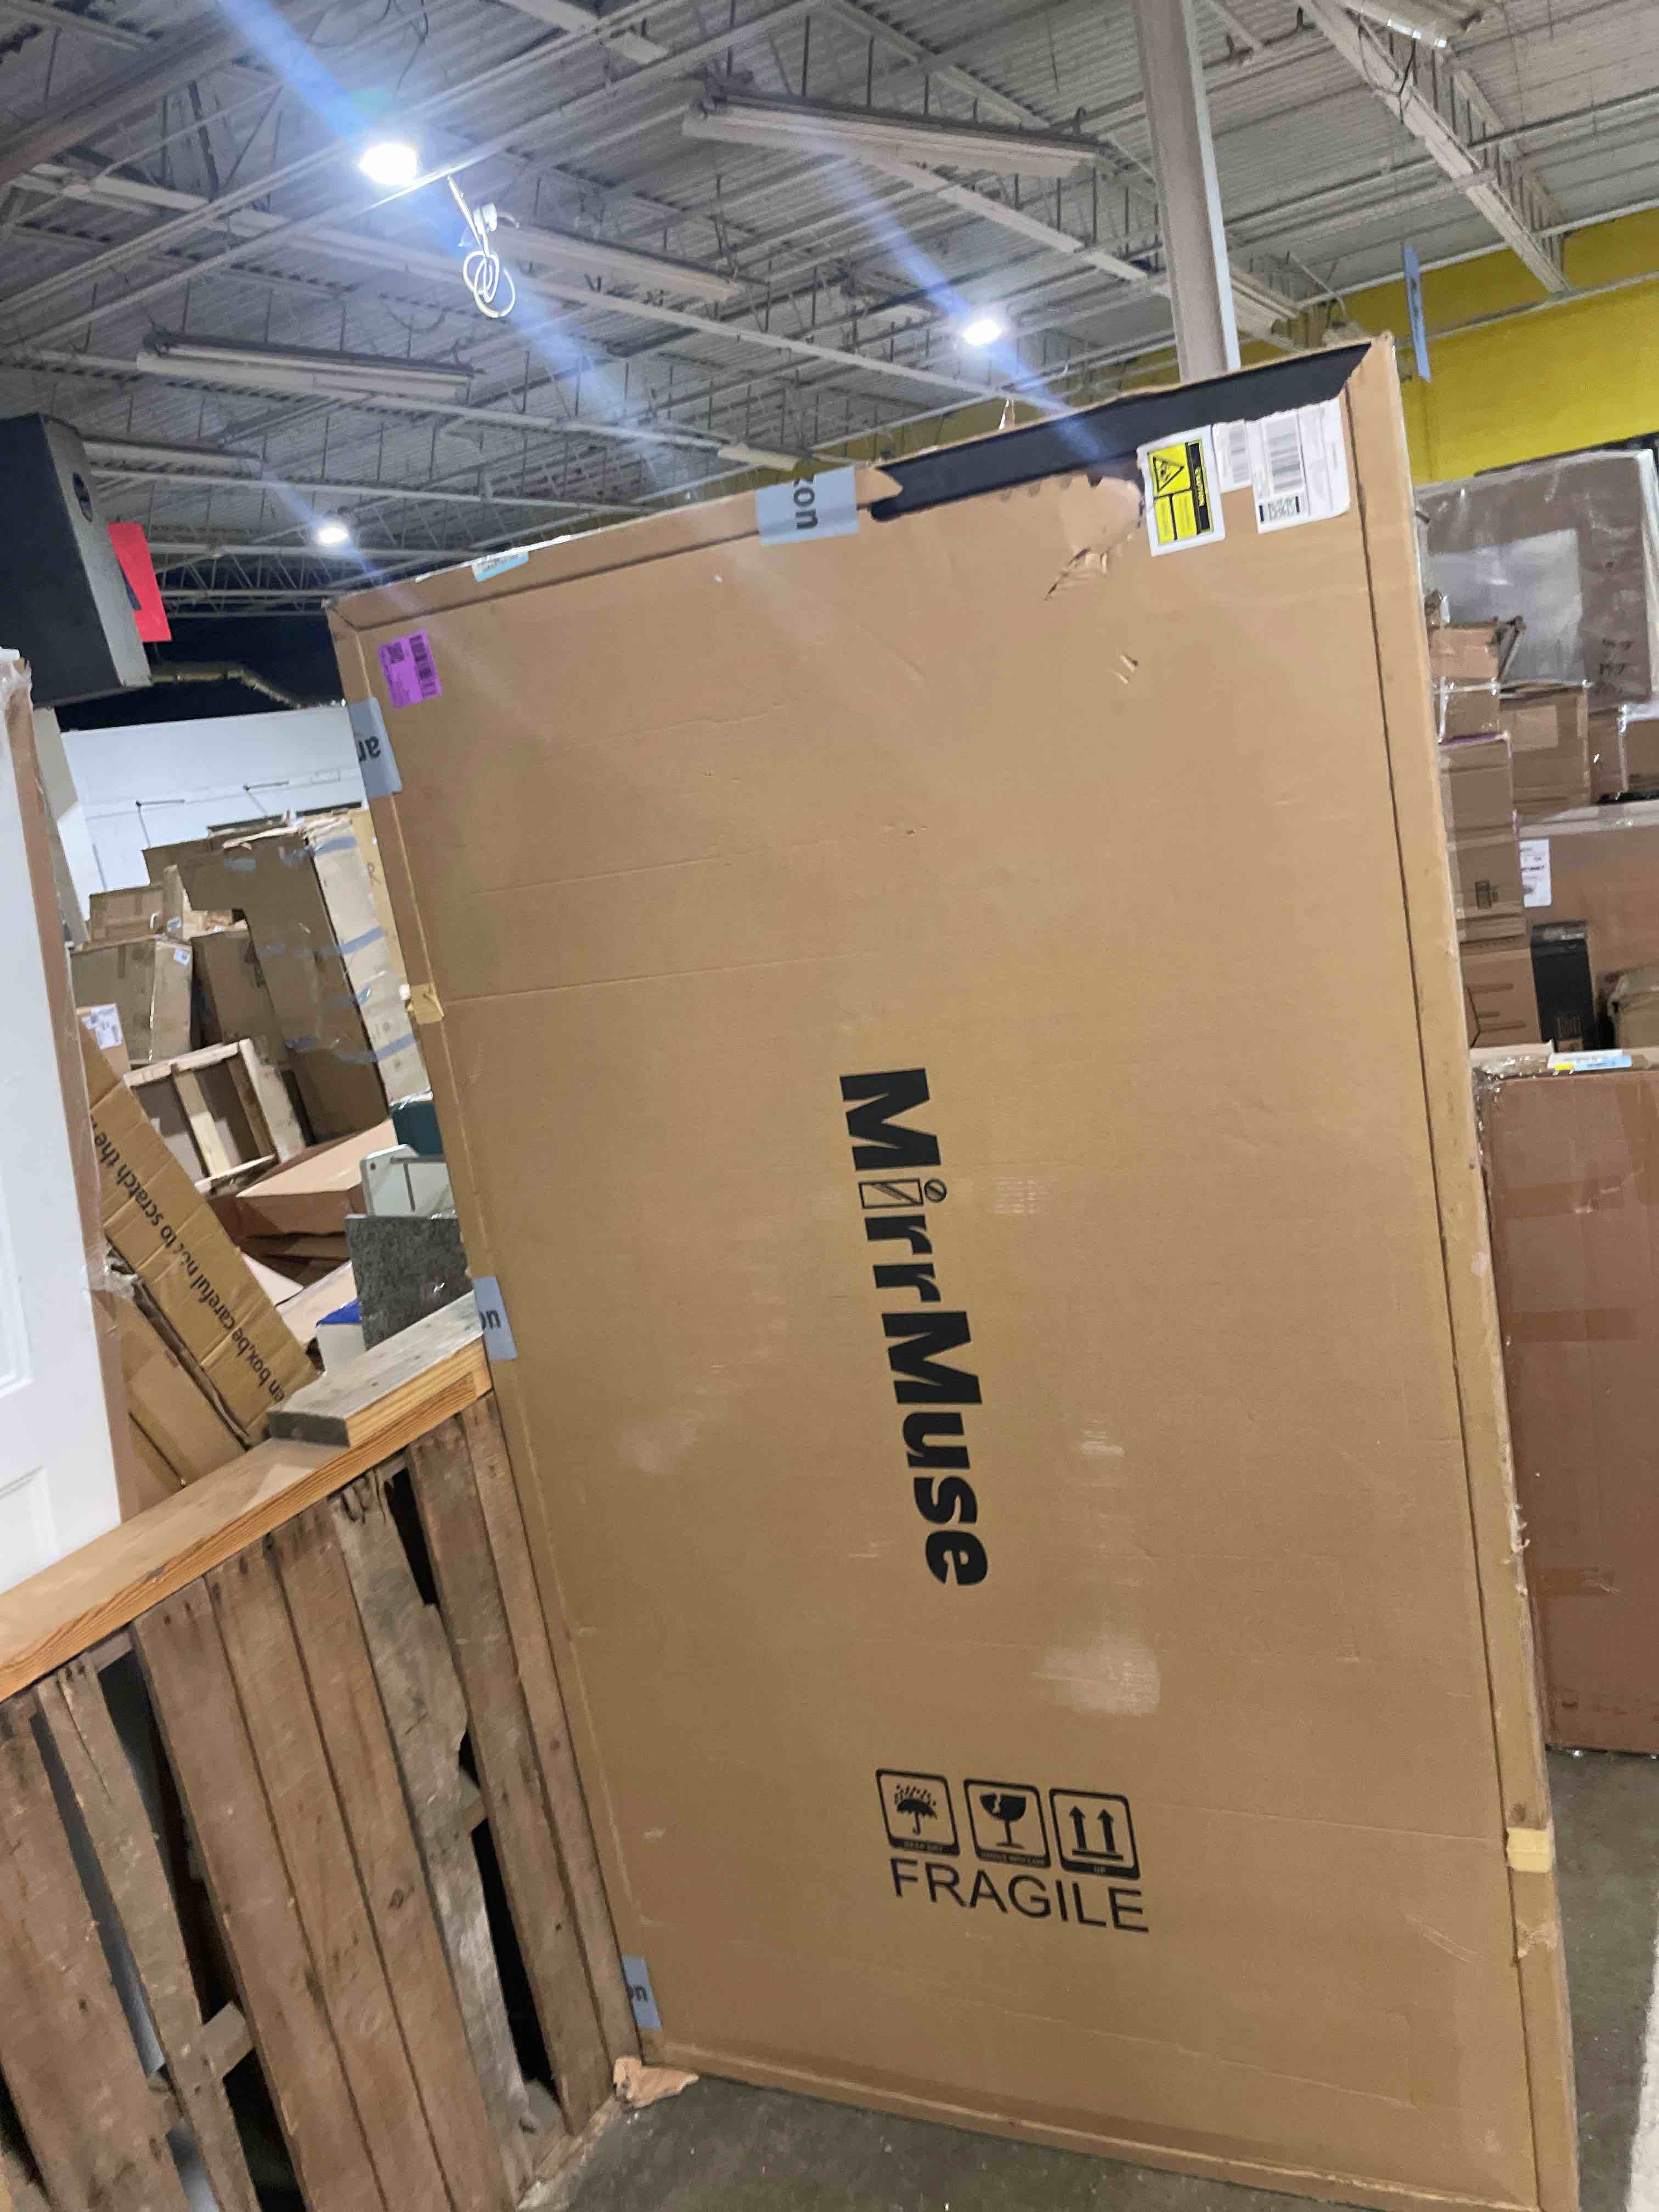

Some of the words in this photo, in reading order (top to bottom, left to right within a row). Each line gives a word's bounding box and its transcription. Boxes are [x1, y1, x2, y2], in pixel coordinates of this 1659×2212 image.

[94, 1132, 120, 1167] the
[117, 1163, 163, 1226] scratch
[160, 1224, 178, 1248] to
[190, 1275, 235, 1330] careful
[839, 1068, 988, 1586] MirrMuse
[890, 1857, 1149, 1933] FRAGILE
